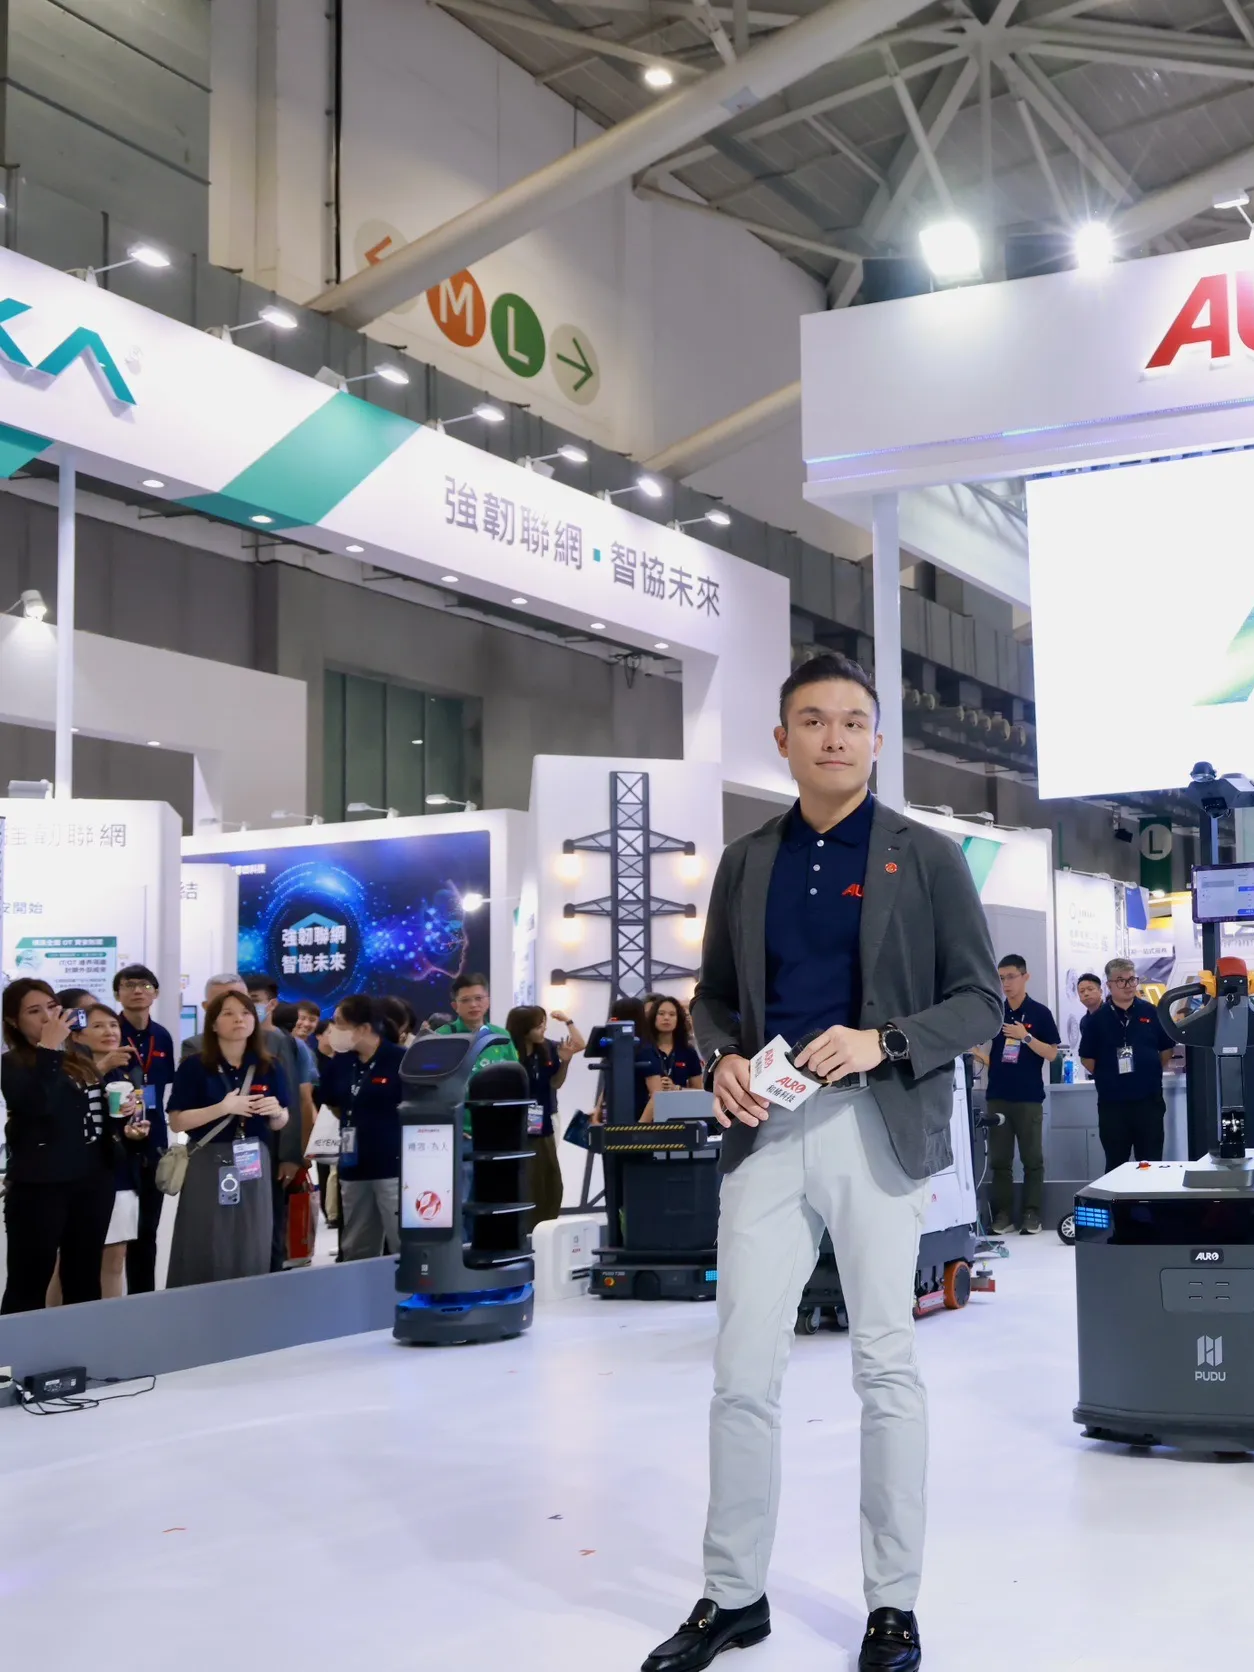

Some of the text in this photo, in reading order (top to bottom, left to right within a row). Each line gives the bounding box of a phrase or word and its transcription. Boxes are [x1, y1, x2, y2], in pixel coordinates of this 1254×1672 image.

[439, 277, 530, 366] M L
[444, 474, 720, 617] 強韌聯網 智協未來
[1149, 830, 1163, 854] L
[282, 952, 346, 975] 智協未來
[775, 1076, 807, 1093] AURO
[1195, 1252, 1220, 1261] AURO
[1195, 1371, 1226, 1381] PUDU
